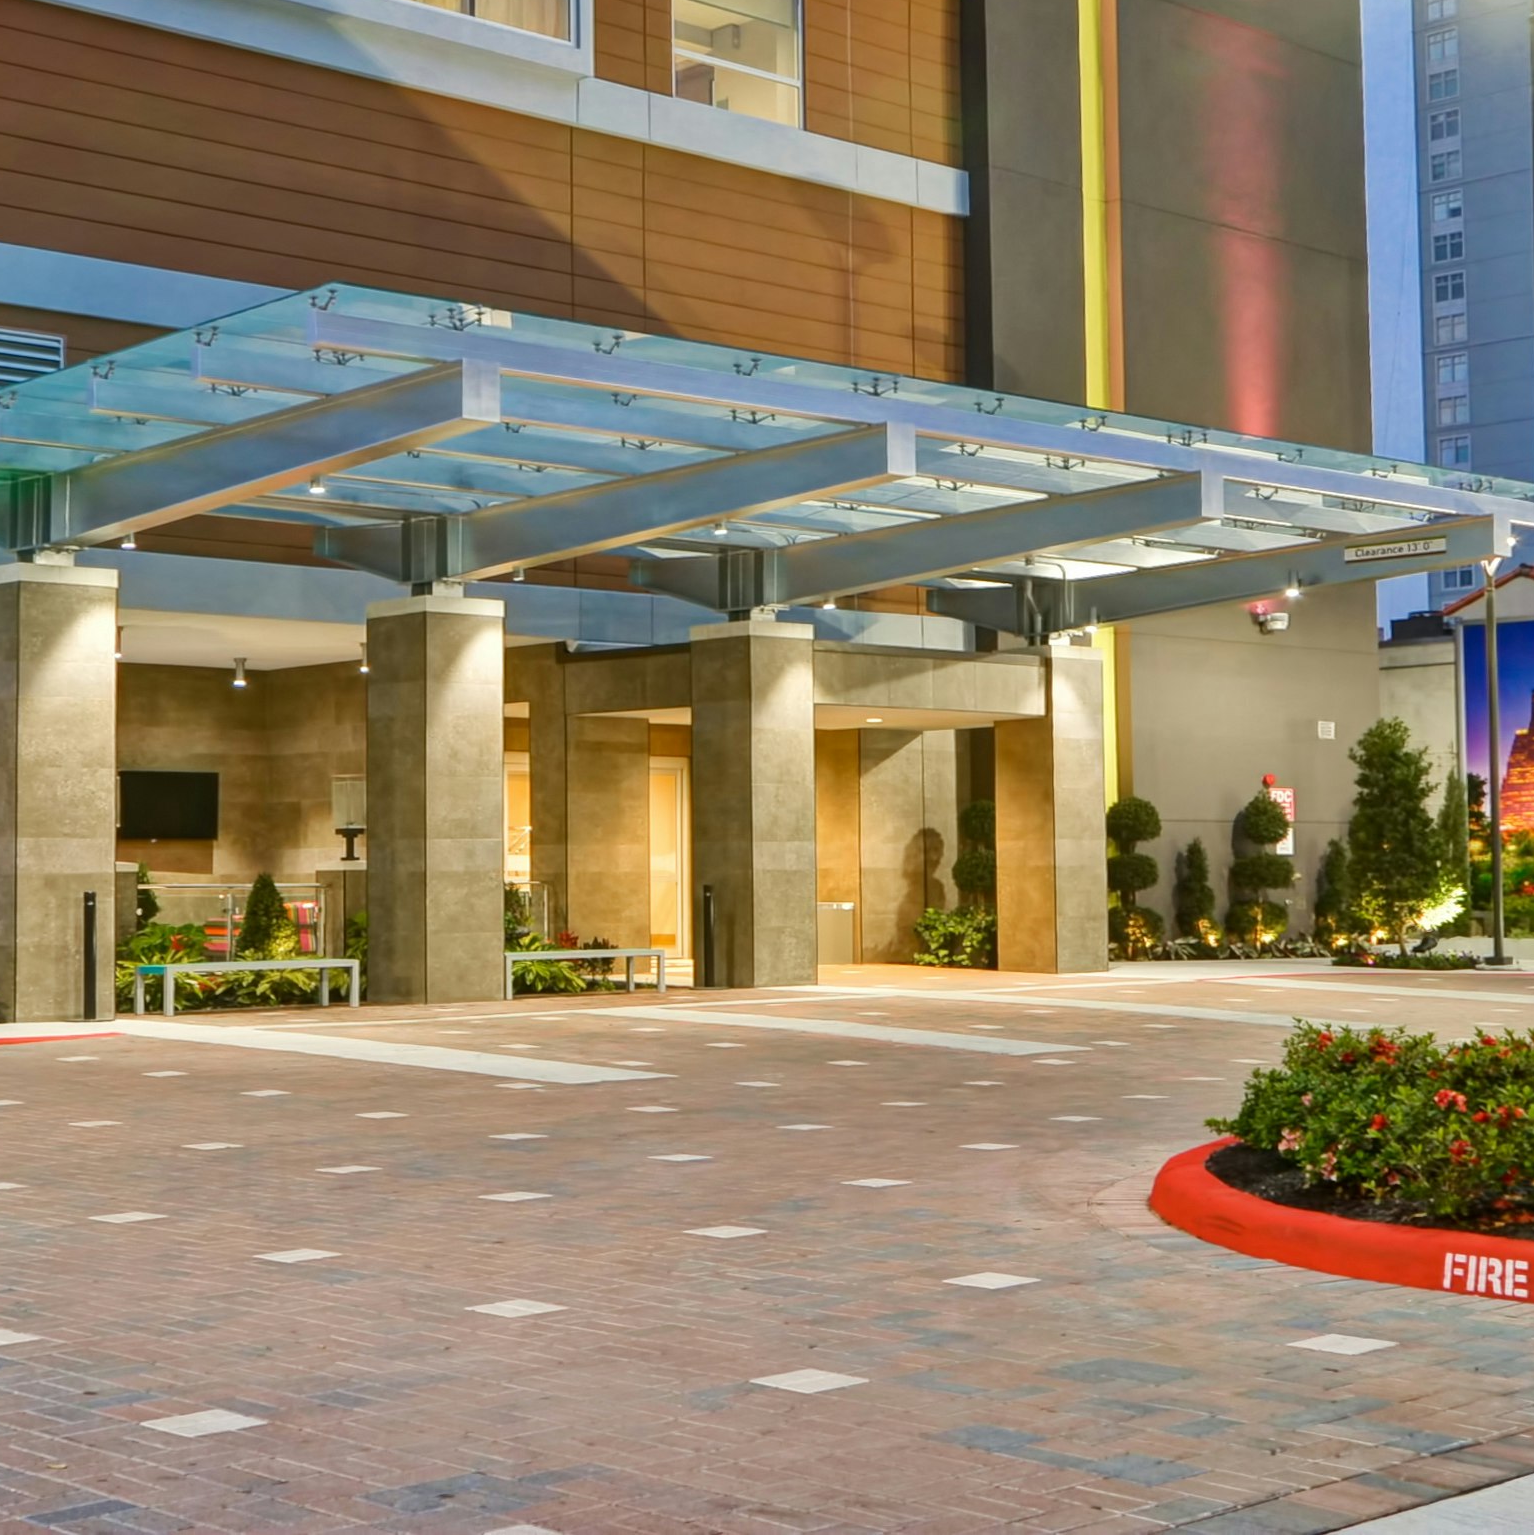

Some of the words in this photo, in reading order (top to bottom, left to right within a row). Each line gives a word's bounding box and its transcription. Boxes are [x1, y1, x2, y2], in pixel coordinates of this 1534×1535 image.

[1354, 547, 1405, 558] Clearance
[1270, 790, 1292, 803] FDC
[1442, 1252, 1529, 1300] FIRE
